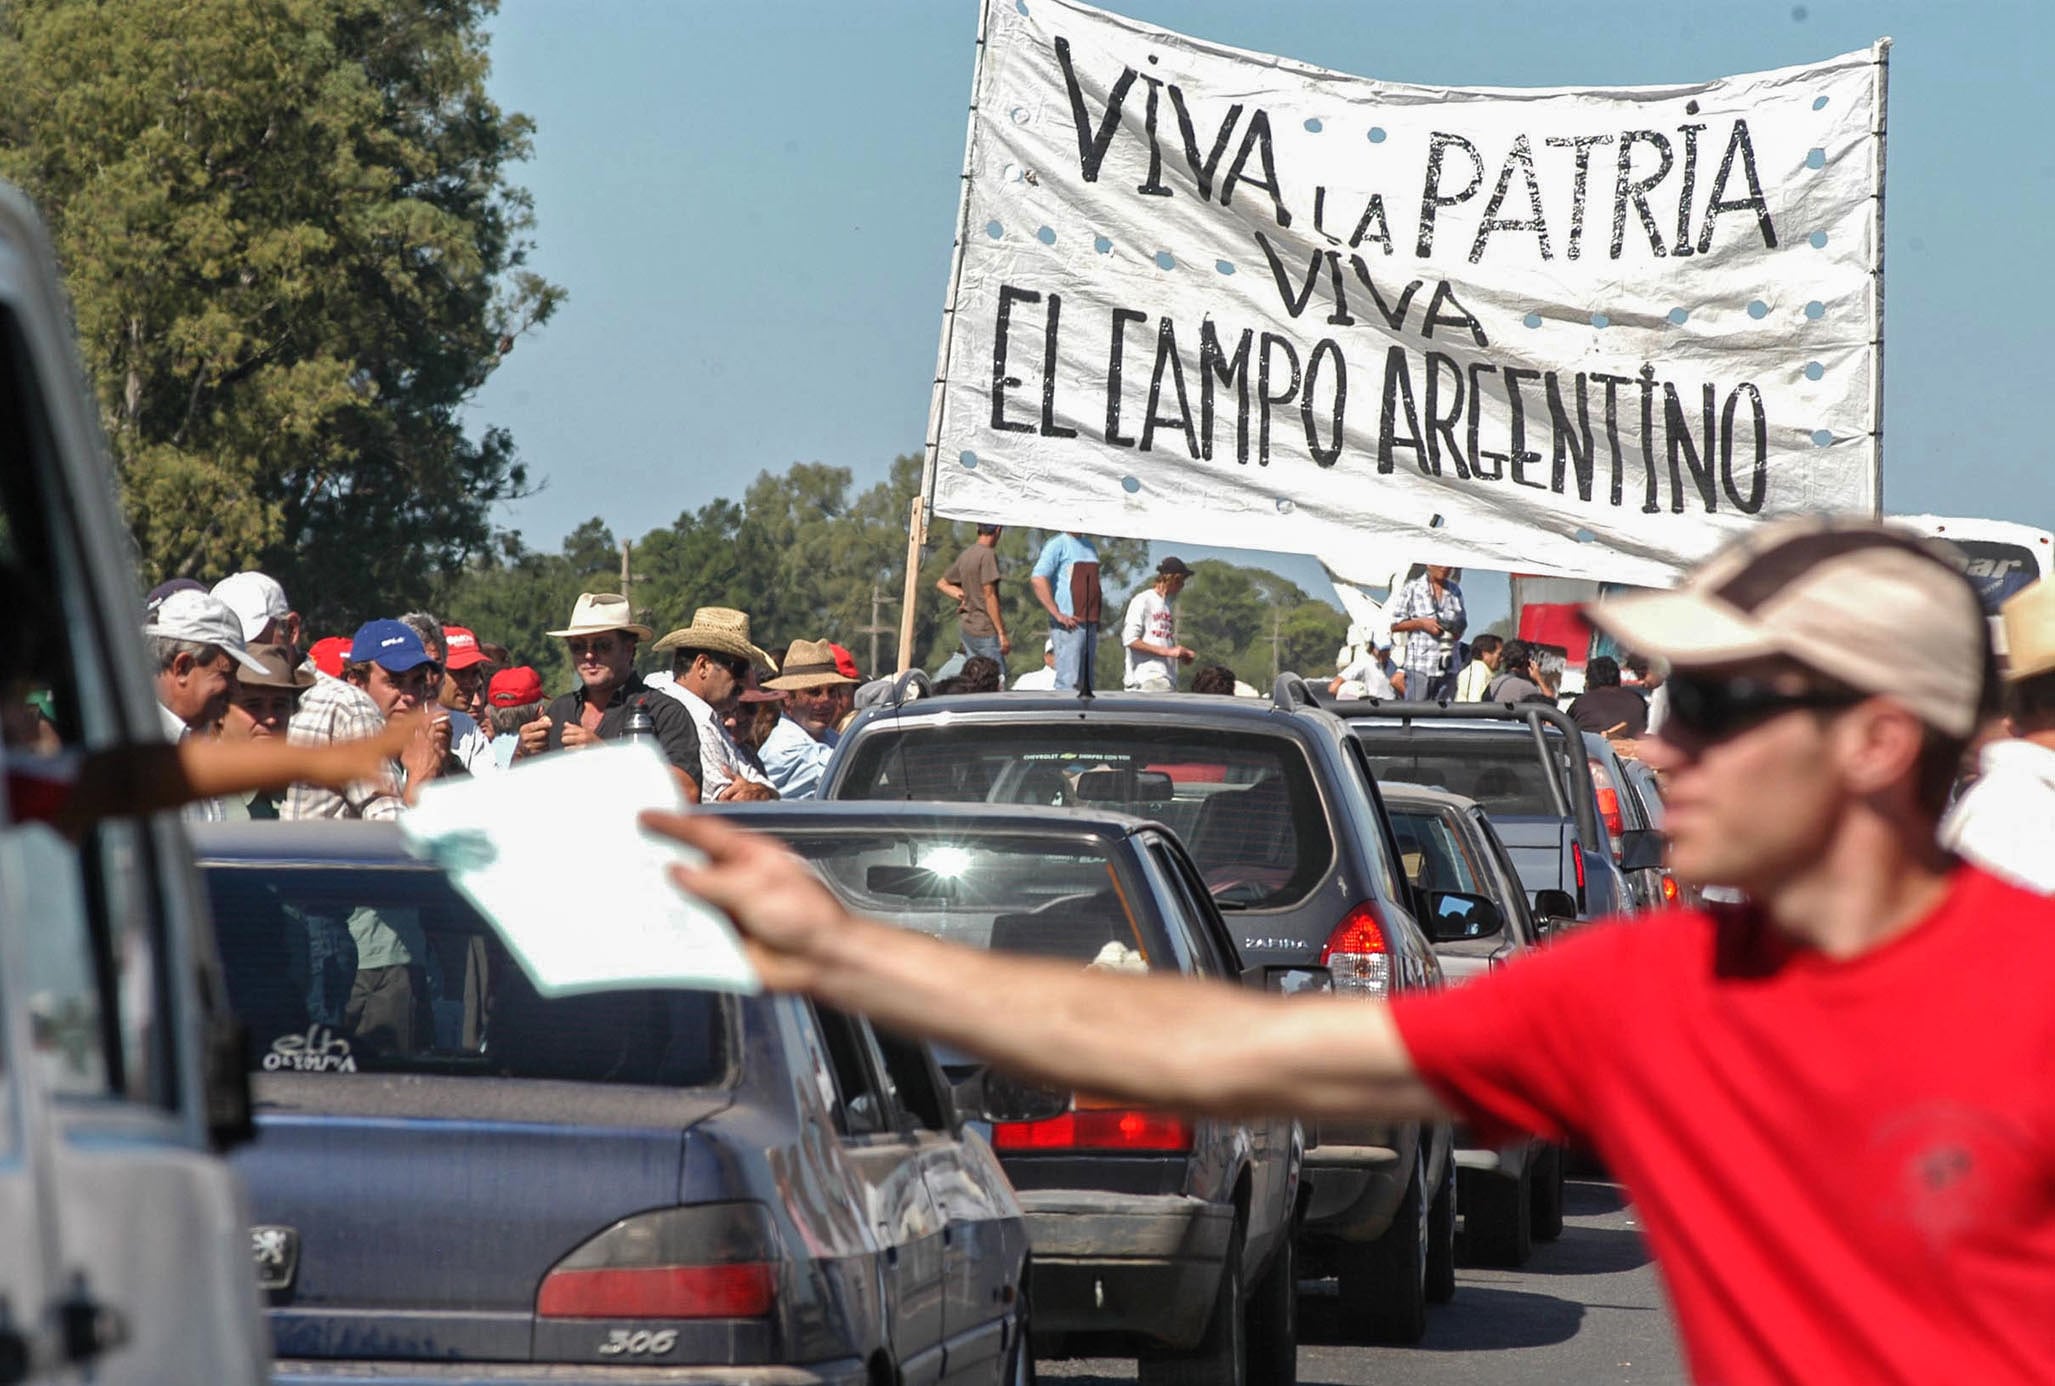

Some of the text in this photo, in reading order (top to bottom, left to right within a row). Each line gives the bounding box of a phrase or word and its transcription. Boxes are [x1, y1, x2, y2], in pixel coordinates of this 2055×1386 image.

[1055, 36, 1777, 264] VIVA LA PATRIA
[1255, 231, 1489, 347] VIVA
[992, 285, 1765, 514] EL CAMPO ARGENTINO
[599, 1329, 678, 1353] 306
